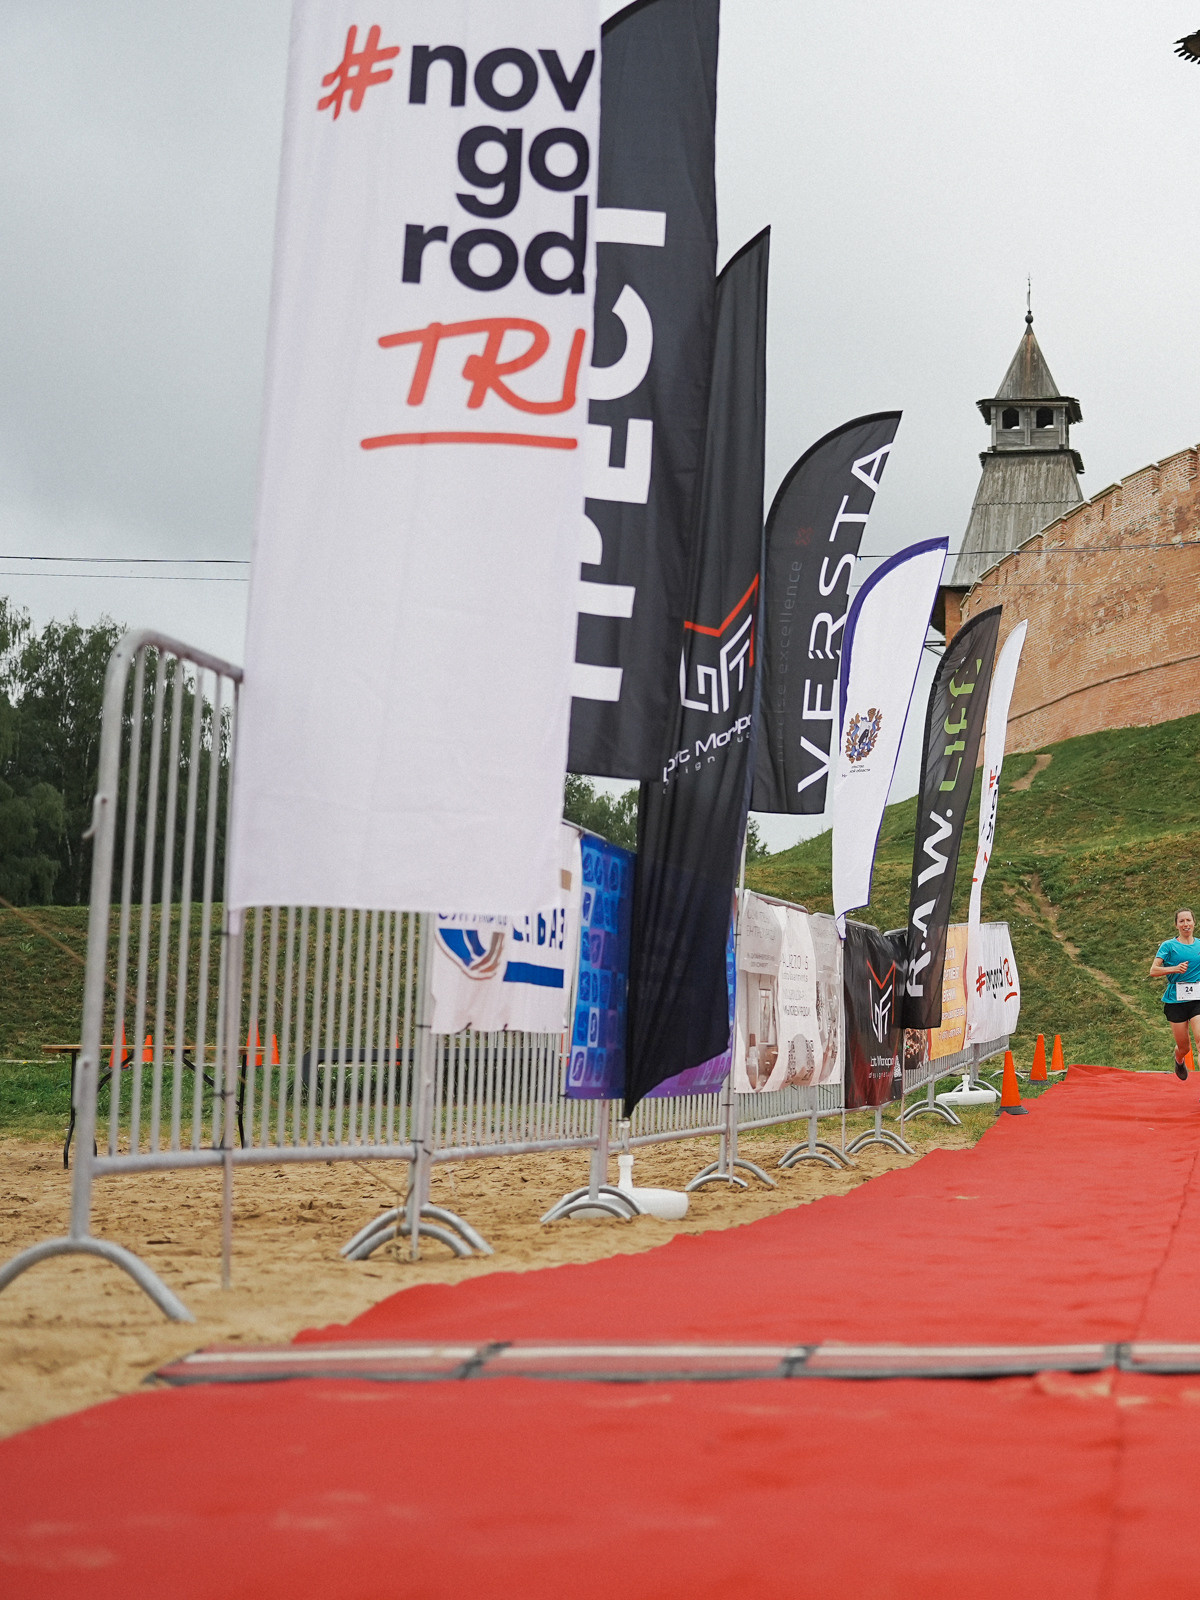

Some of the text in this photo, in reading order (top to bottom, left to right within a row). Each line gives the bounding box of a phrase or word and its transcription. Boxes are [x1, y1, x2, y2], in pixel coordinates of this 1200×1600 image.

[316, 24, 595, 121] #nov
[456, 124, 590, 219] go
[401, 195, 588, 295] rod
[377, 317, 586, 415] TRI
[778, 559, 803, 674] excellence
[798, 442, 893, 793] VERSTA
